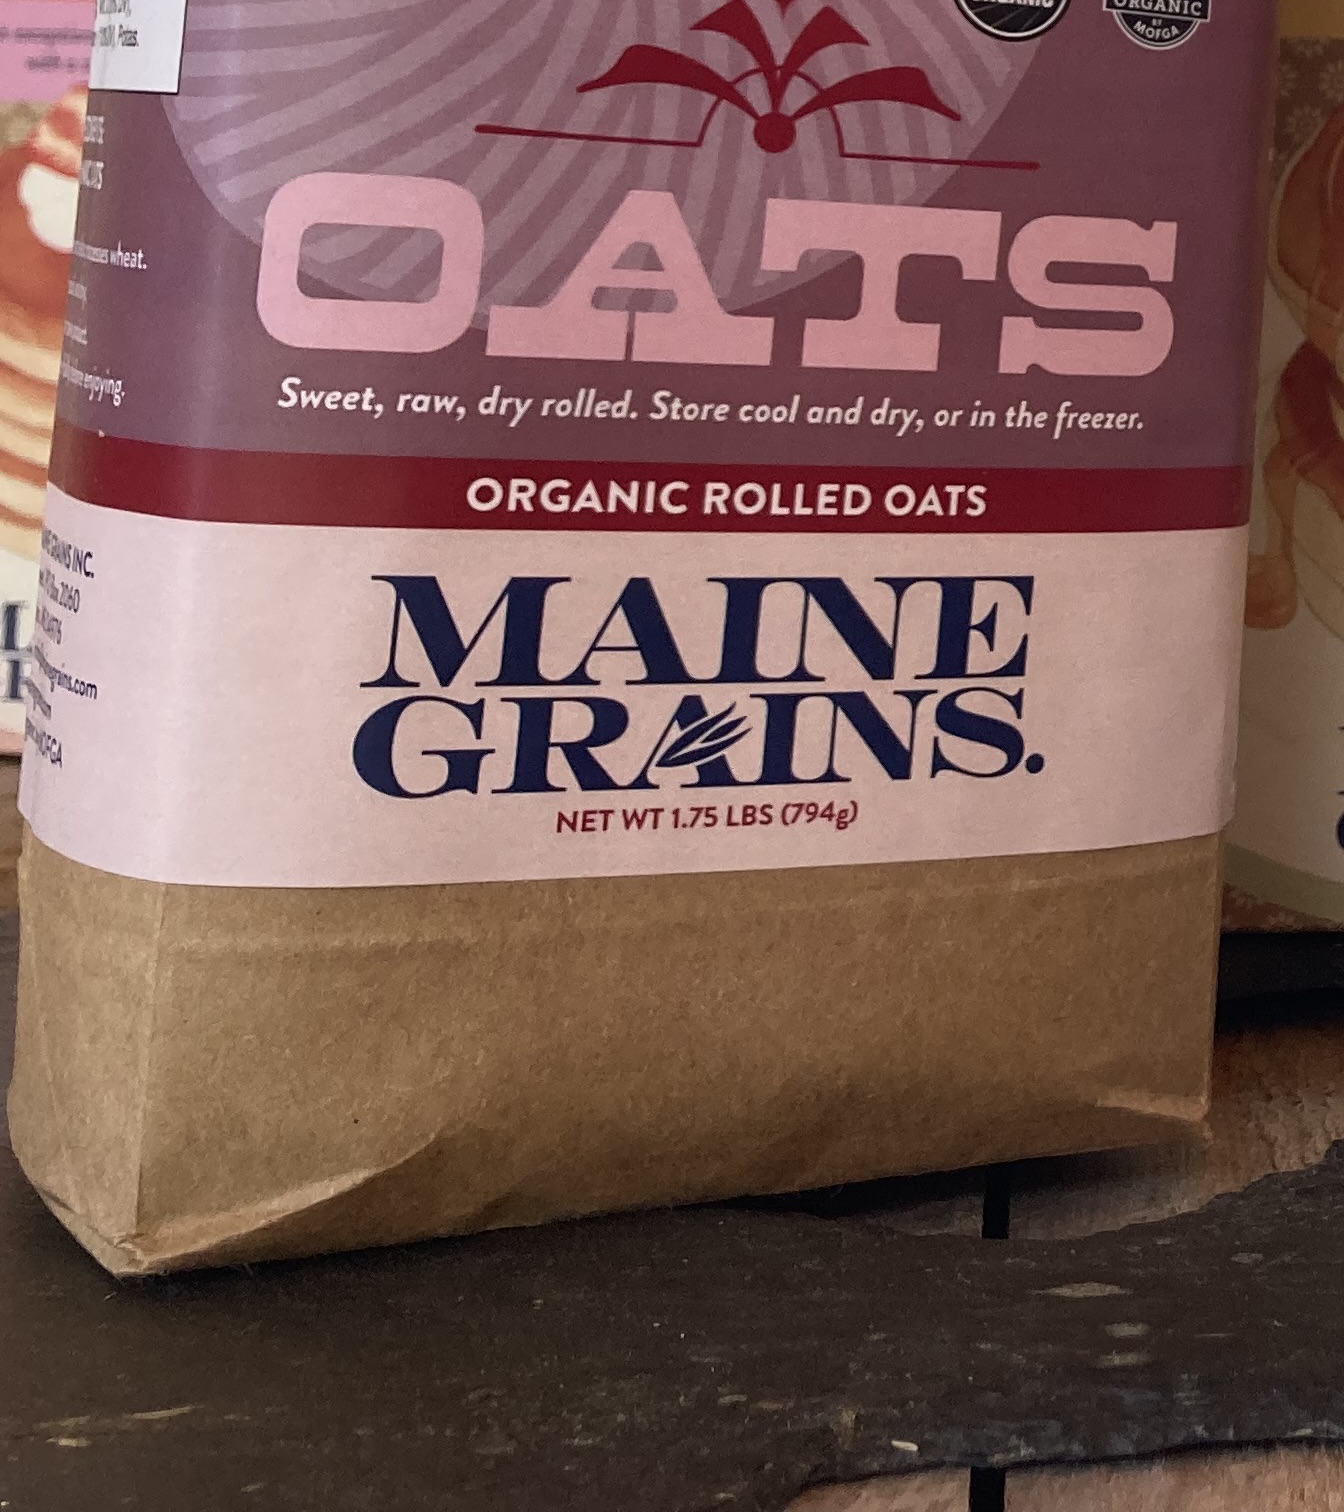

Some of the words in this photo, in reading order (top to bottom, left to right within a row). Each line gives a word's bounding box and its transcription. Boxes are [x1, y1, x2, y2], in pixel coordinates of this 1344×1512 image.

[1134, 19, 1181, 41] MOFGA
[254, 170, 1179, 379] OATS
[277, 376, 385, 419] Sweet,
[396, 391, 468, 421] raw,
[477, 385, 533, 428] dry
[540, 388, 639, 420] rolled.
[648, 389, 730, 422] Store
[738, 394, 800, 424] cool
[806, 396, 865, 426] and
[870, 396, 926, 437] dry,
[933, 406, 962, 428] or
[969, 400, 996, 428] in
[1004, 401, 1047, 429] the
[1052, 400, 1144, 440] freezer.
[465, 476, 690, 515] ORGANIC
[702, 481, 873, 516] ROLLED
[883, 483, 989, 517] OATS
[358, 574, 1037, 689] MAINE
[350, 686, 1047, 800] GRAINS.
[556, 808, 615, 835] NET
[622, 807, 666, 832] WT
[671, 804, 719, 831] 1.75
[725, 802, 774, 828] LBS
[780, 799, 860, 831] (794g)
